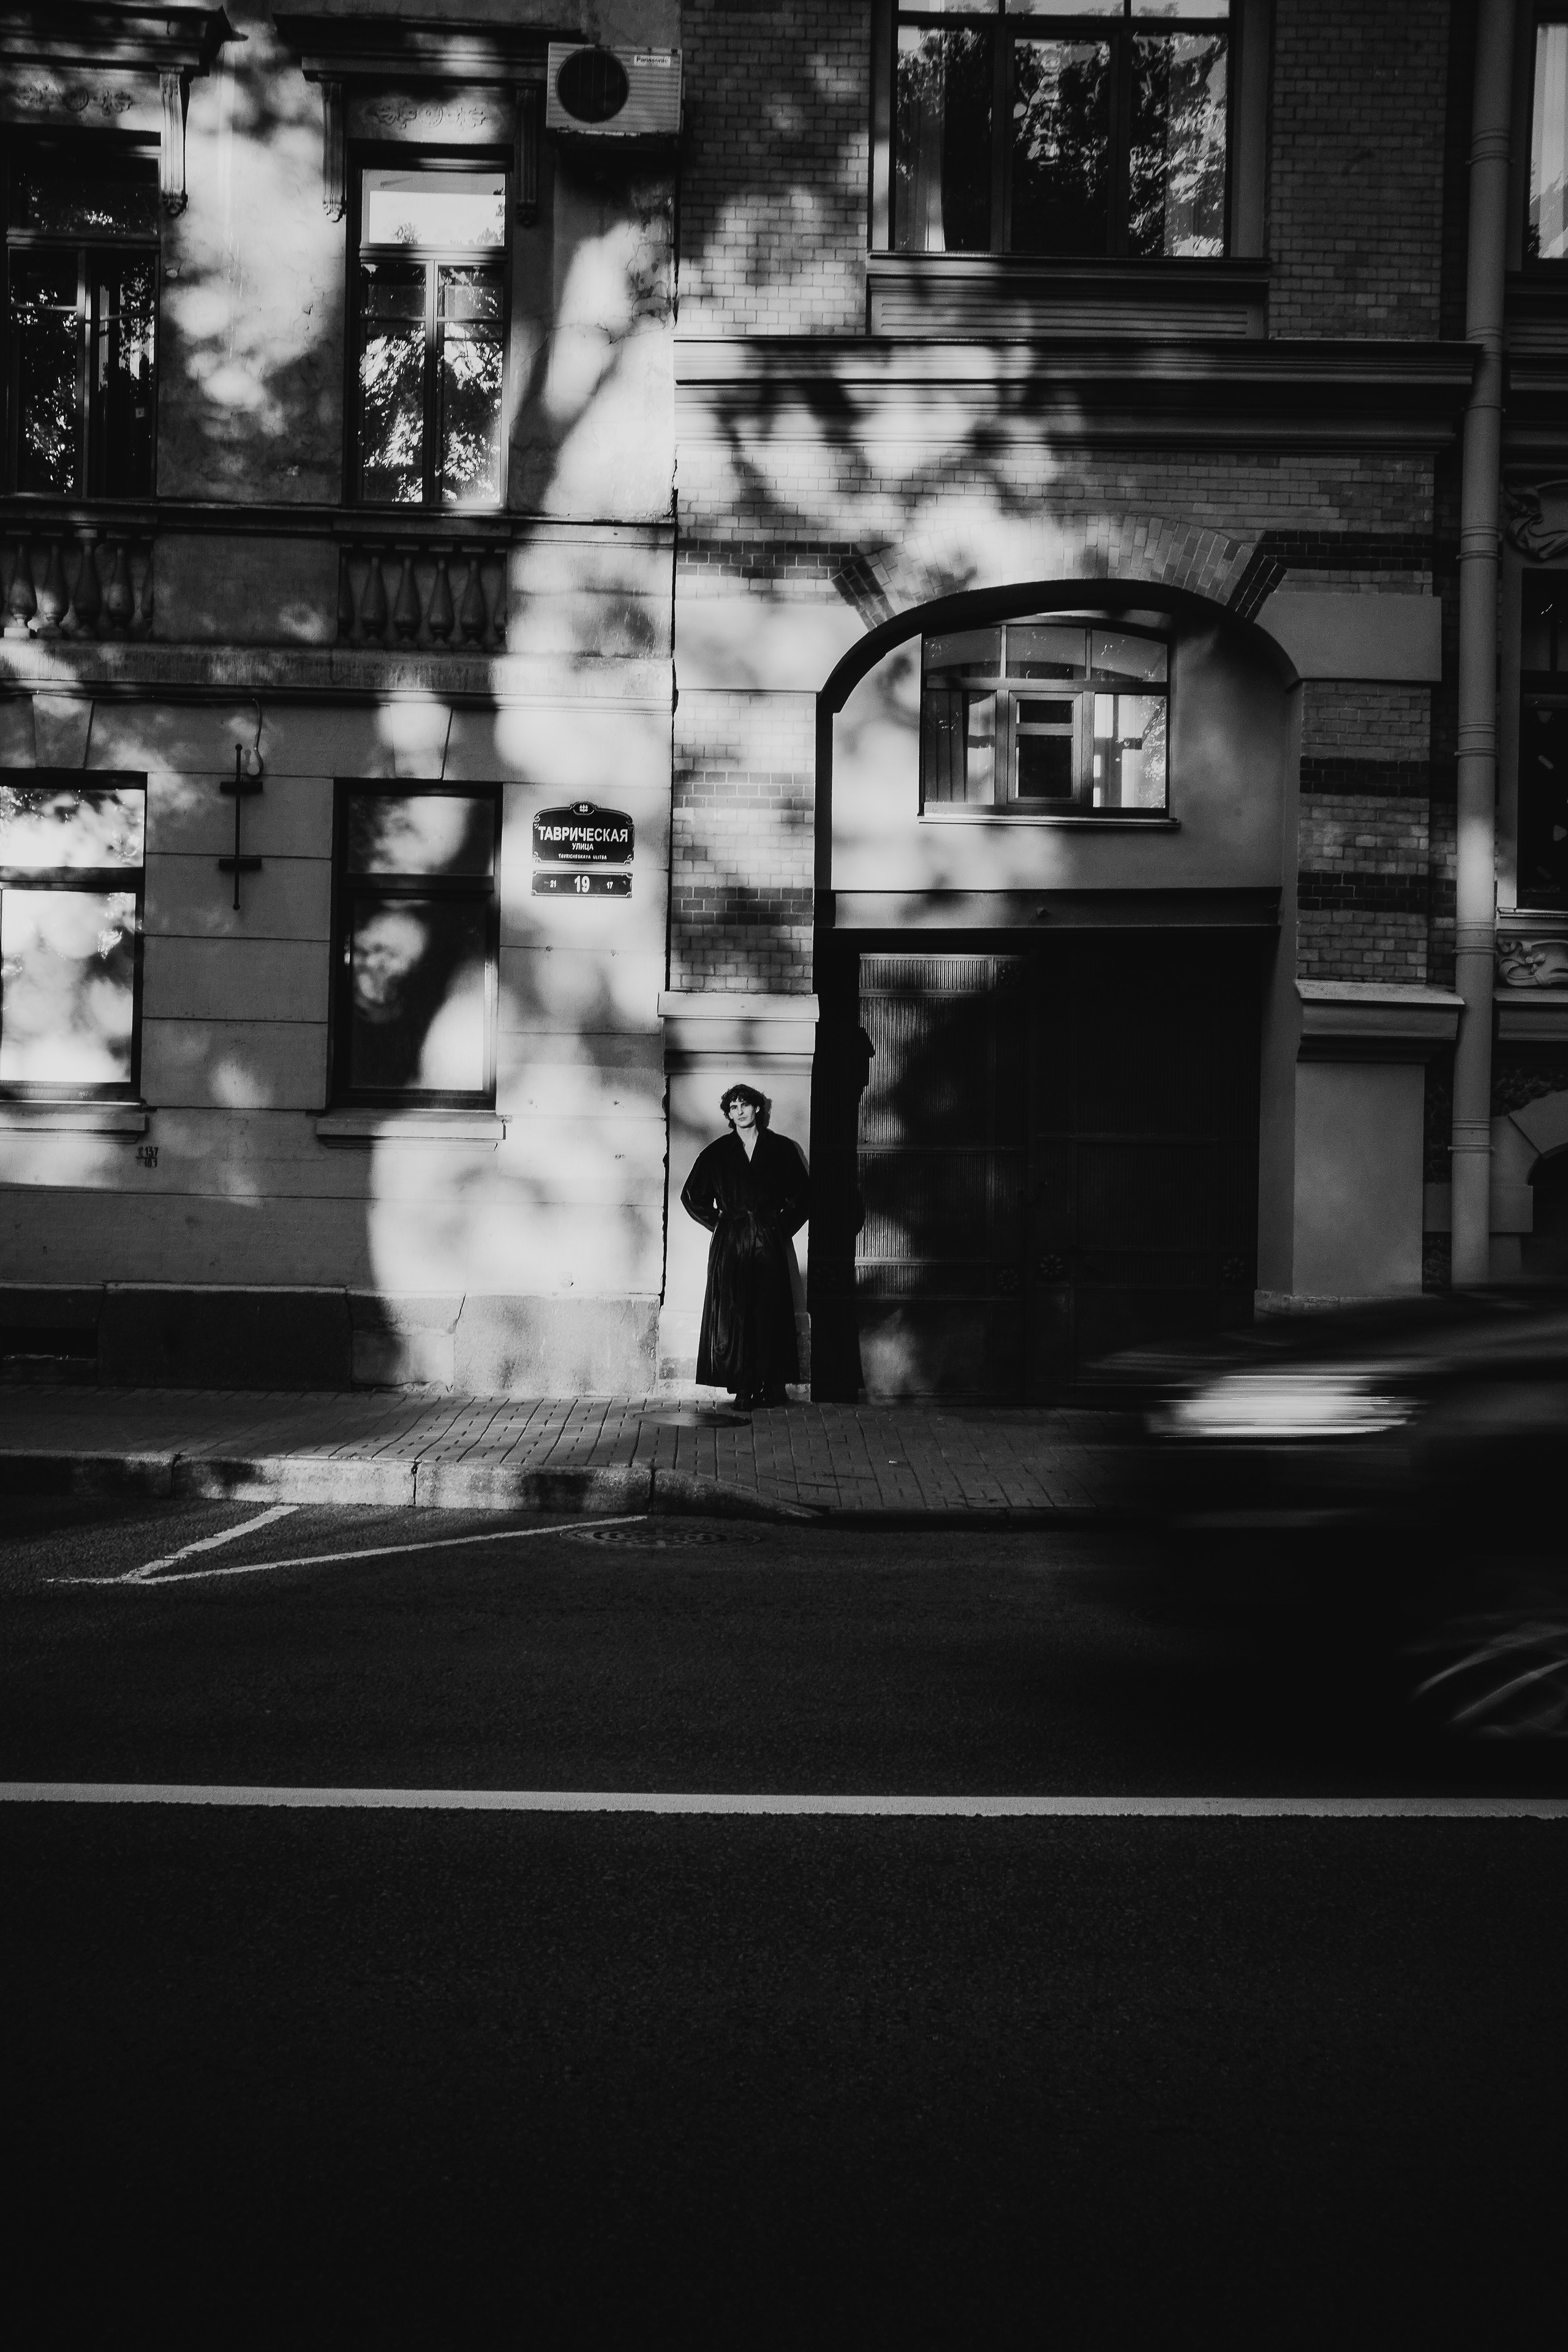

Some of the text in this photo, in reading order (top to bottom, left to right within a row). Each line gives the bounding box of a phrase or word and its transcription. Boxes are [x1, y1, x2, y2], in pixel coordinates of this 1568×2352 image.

[538, 826, 628, 842] ТАВРИЧЕСКАЯ
[572, 843, 594, 851] УЛИЦА
[549, 880, 557, 888] 21
[574, 875, 590, 893] 19
